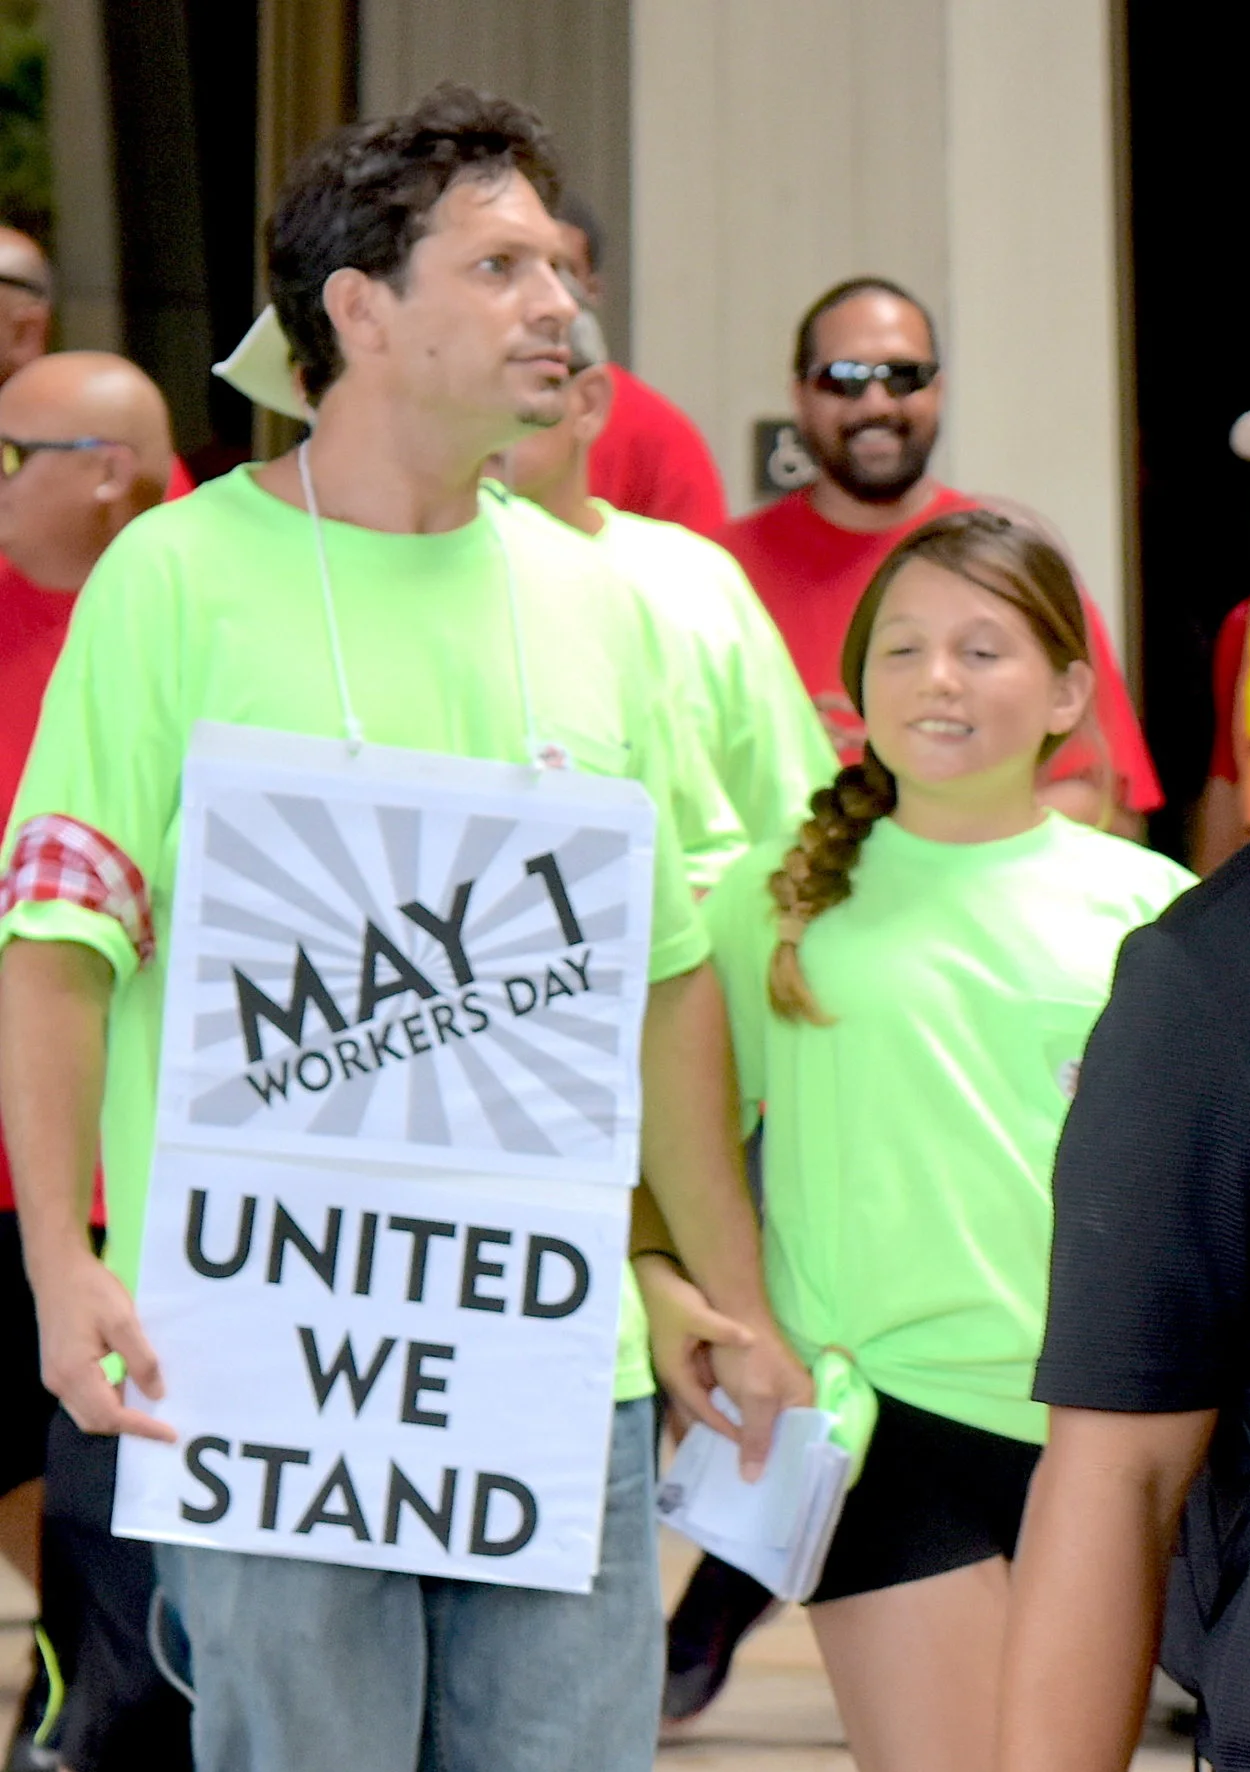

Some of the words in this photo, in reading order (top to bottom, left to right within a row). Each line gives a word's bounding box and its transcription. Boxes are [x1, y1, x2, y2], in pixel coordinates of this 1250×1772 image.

[231, 879, 476, 1064] MAY
[524, 851, 587, 948] 1
[244, 991, 490, 1107] WORKERS
[504, 949, 593, 1017] DAY
[183, 1188, 591, 1321] UNITED
[296, 1326, 456, 1429] WE
[178, 1435, 539, 1558] STAND
